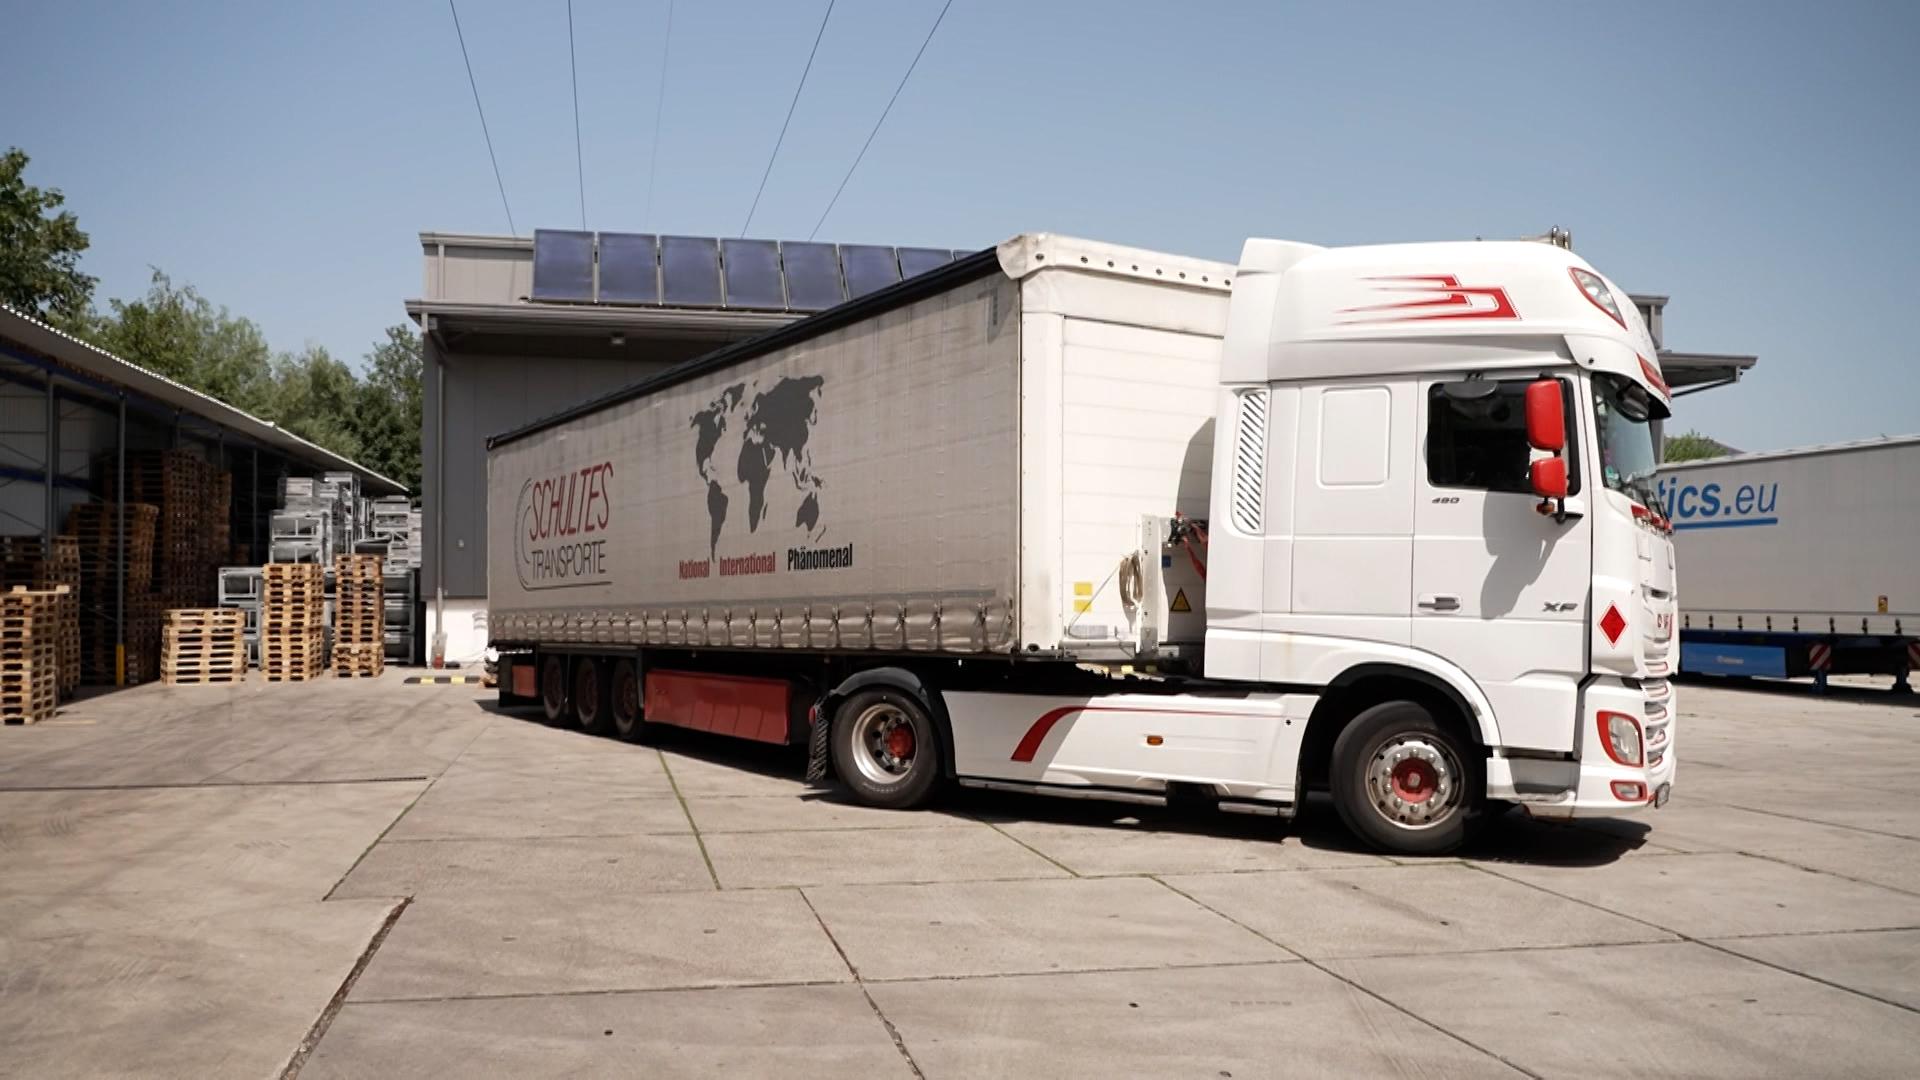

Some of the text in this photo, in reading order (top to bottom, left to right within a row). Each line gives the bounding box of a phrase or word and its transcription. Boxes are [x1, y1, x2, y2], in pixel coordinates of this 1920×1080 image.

[530, 461, 613, 541] SCHULTES
[531, 540, 606, 579] TRANSPORTE
[679, 542, 853, 580] National International Phänomenal
[1542, 602, 1577, 612] XF
